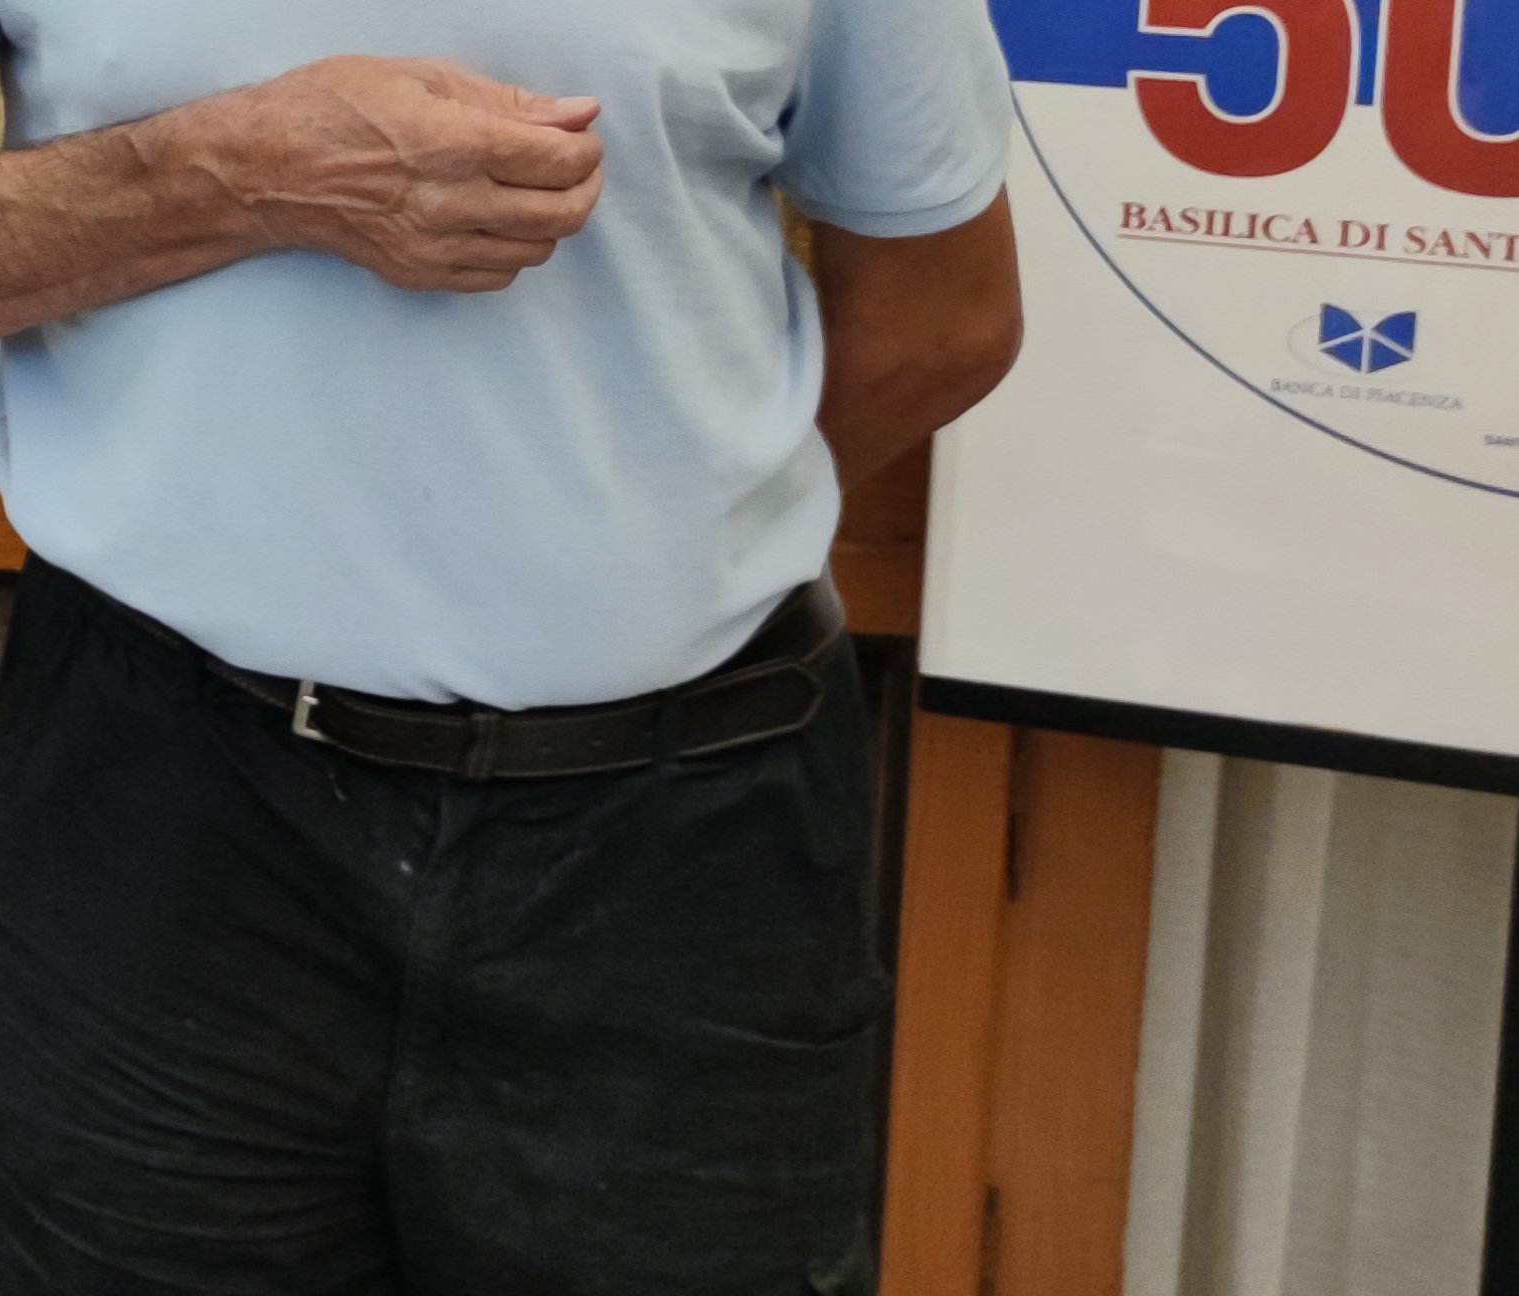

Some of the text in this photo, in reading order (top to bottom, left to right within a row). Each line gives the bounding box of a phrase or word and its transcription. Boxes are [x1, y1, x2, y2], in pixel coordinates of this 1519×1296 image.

[1119, 200, 1319, 245] BASILICA
[1337, 218, 1390, 252] DI
[1270, 378, 1464, 411] BANCA DI PIACENZA
